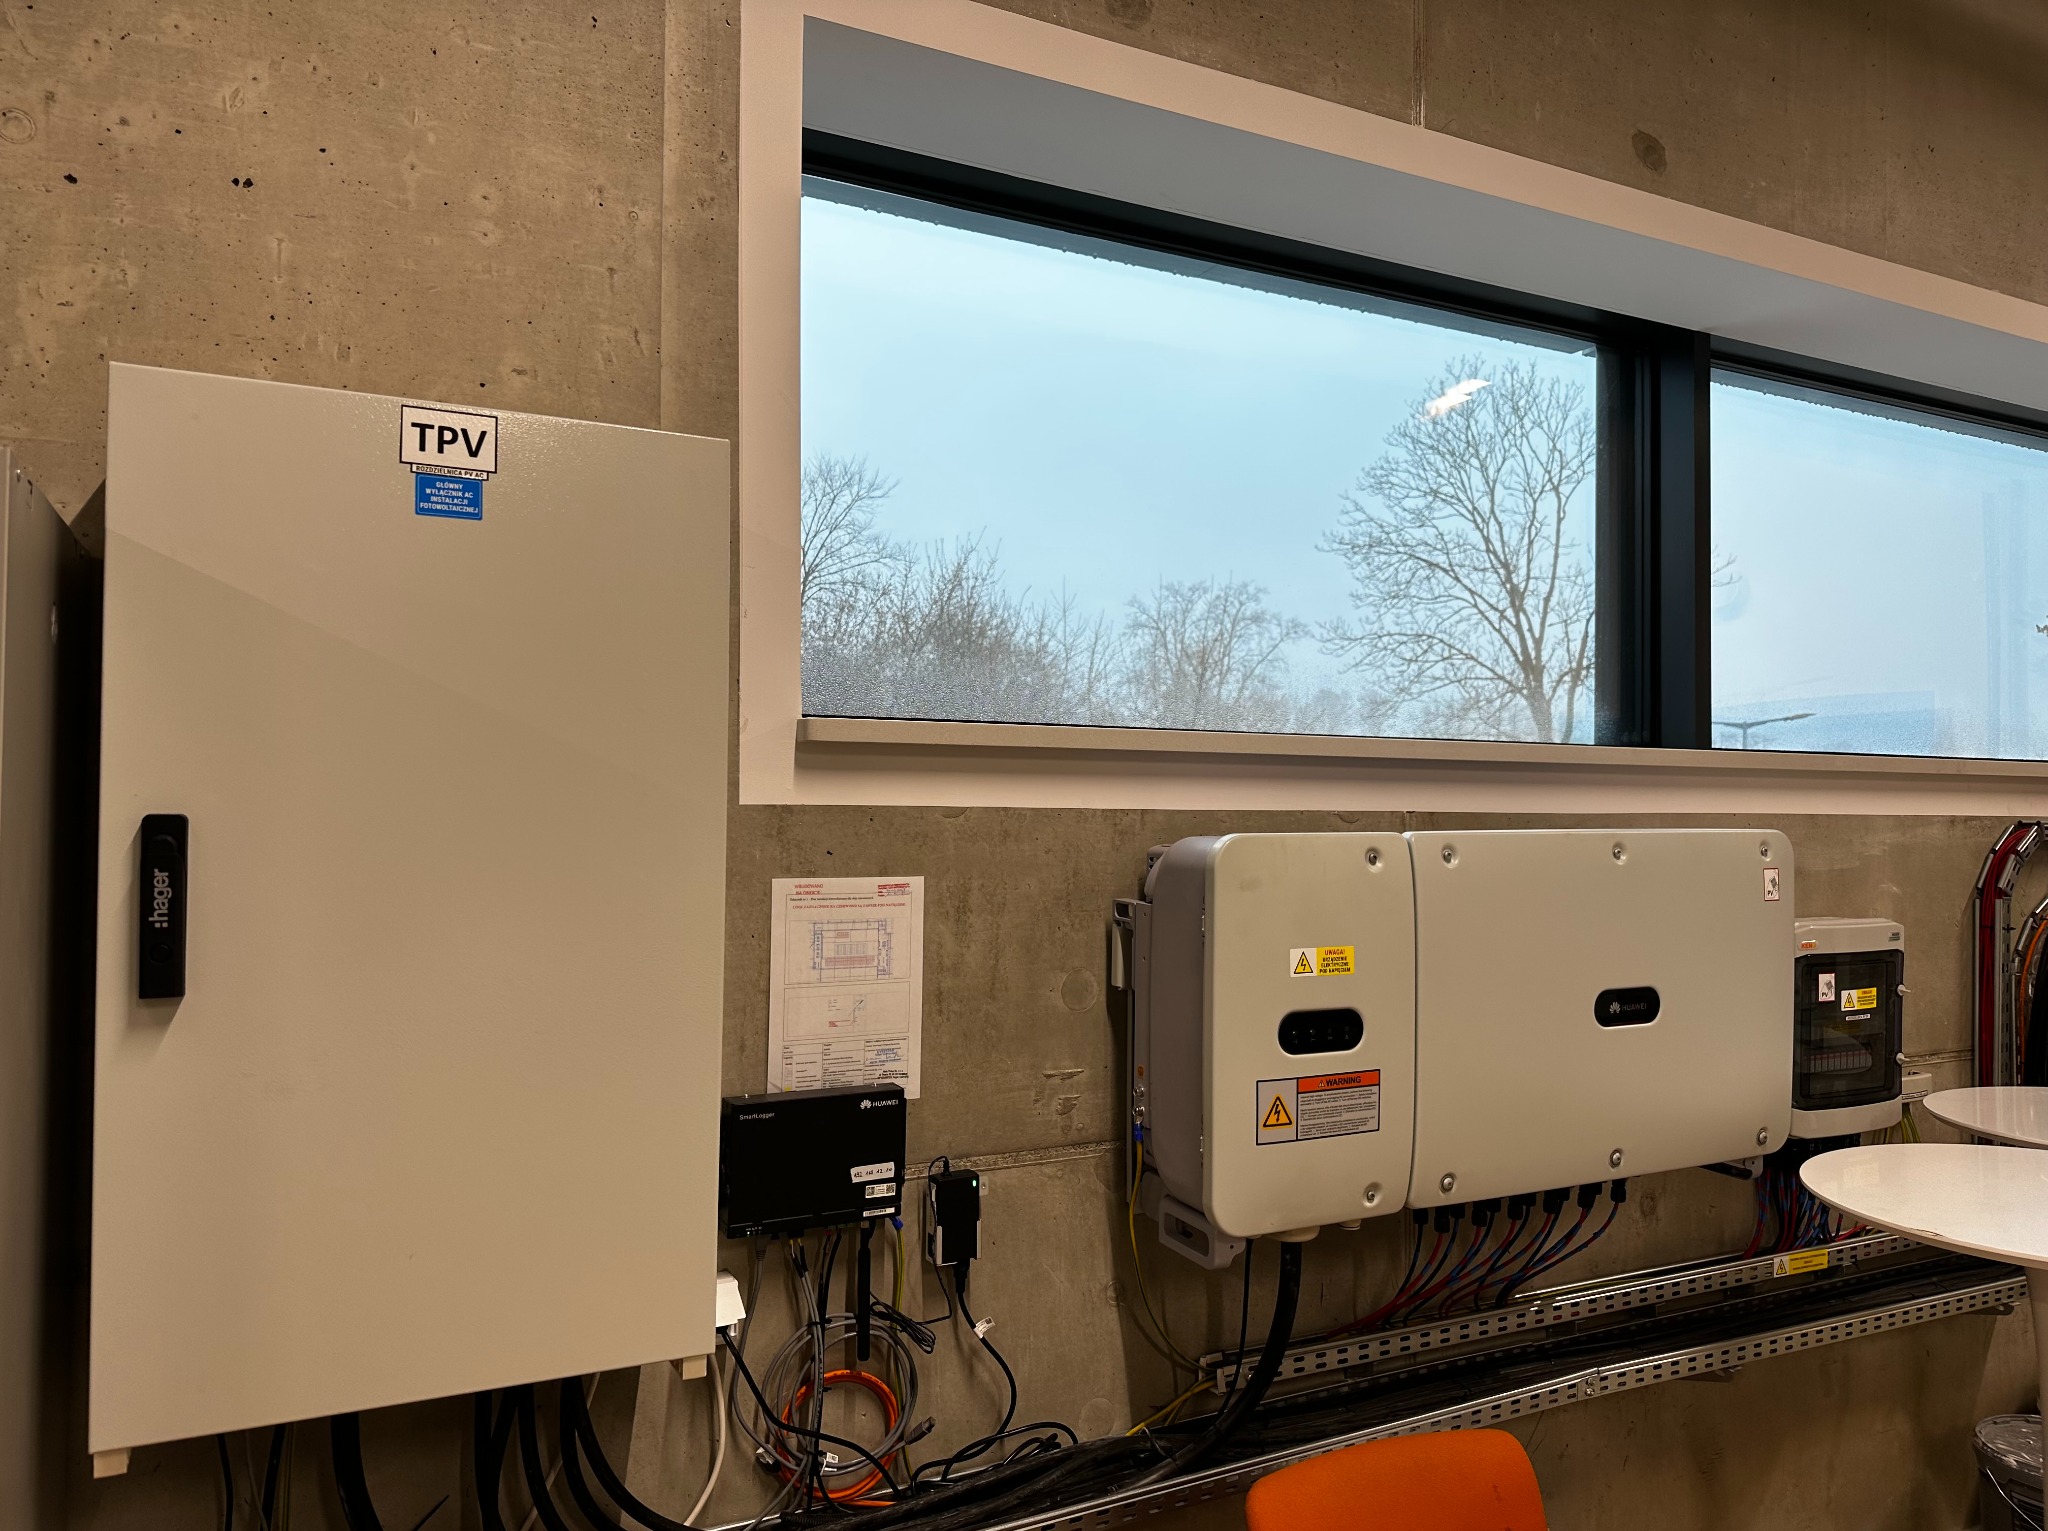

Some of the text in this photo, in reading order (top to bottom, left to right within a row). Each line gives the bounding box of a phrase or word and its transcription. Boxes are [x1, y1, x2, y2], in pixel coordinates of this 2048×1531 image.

[411, 422, 487, 458] TPV
[416, 465, 462, 476] ROZDZIELNICA
[436, 481, 463, 490] GŁÓWNY
[425, 488, 463, 498] WYŁĄCZNIK
[430, 496, 469, 505] INSTALACJI
[420, 502, 478, 513] FOTOWOLTAICZNEJ
[1621, 1003, 1647, 1011] HUAWEI
[1326, 1076, 1362, 1087] WARNING
[872, 1099, 899, 1107] HUAWEI
[739, 1112, 775, 1121] SmartLogger
